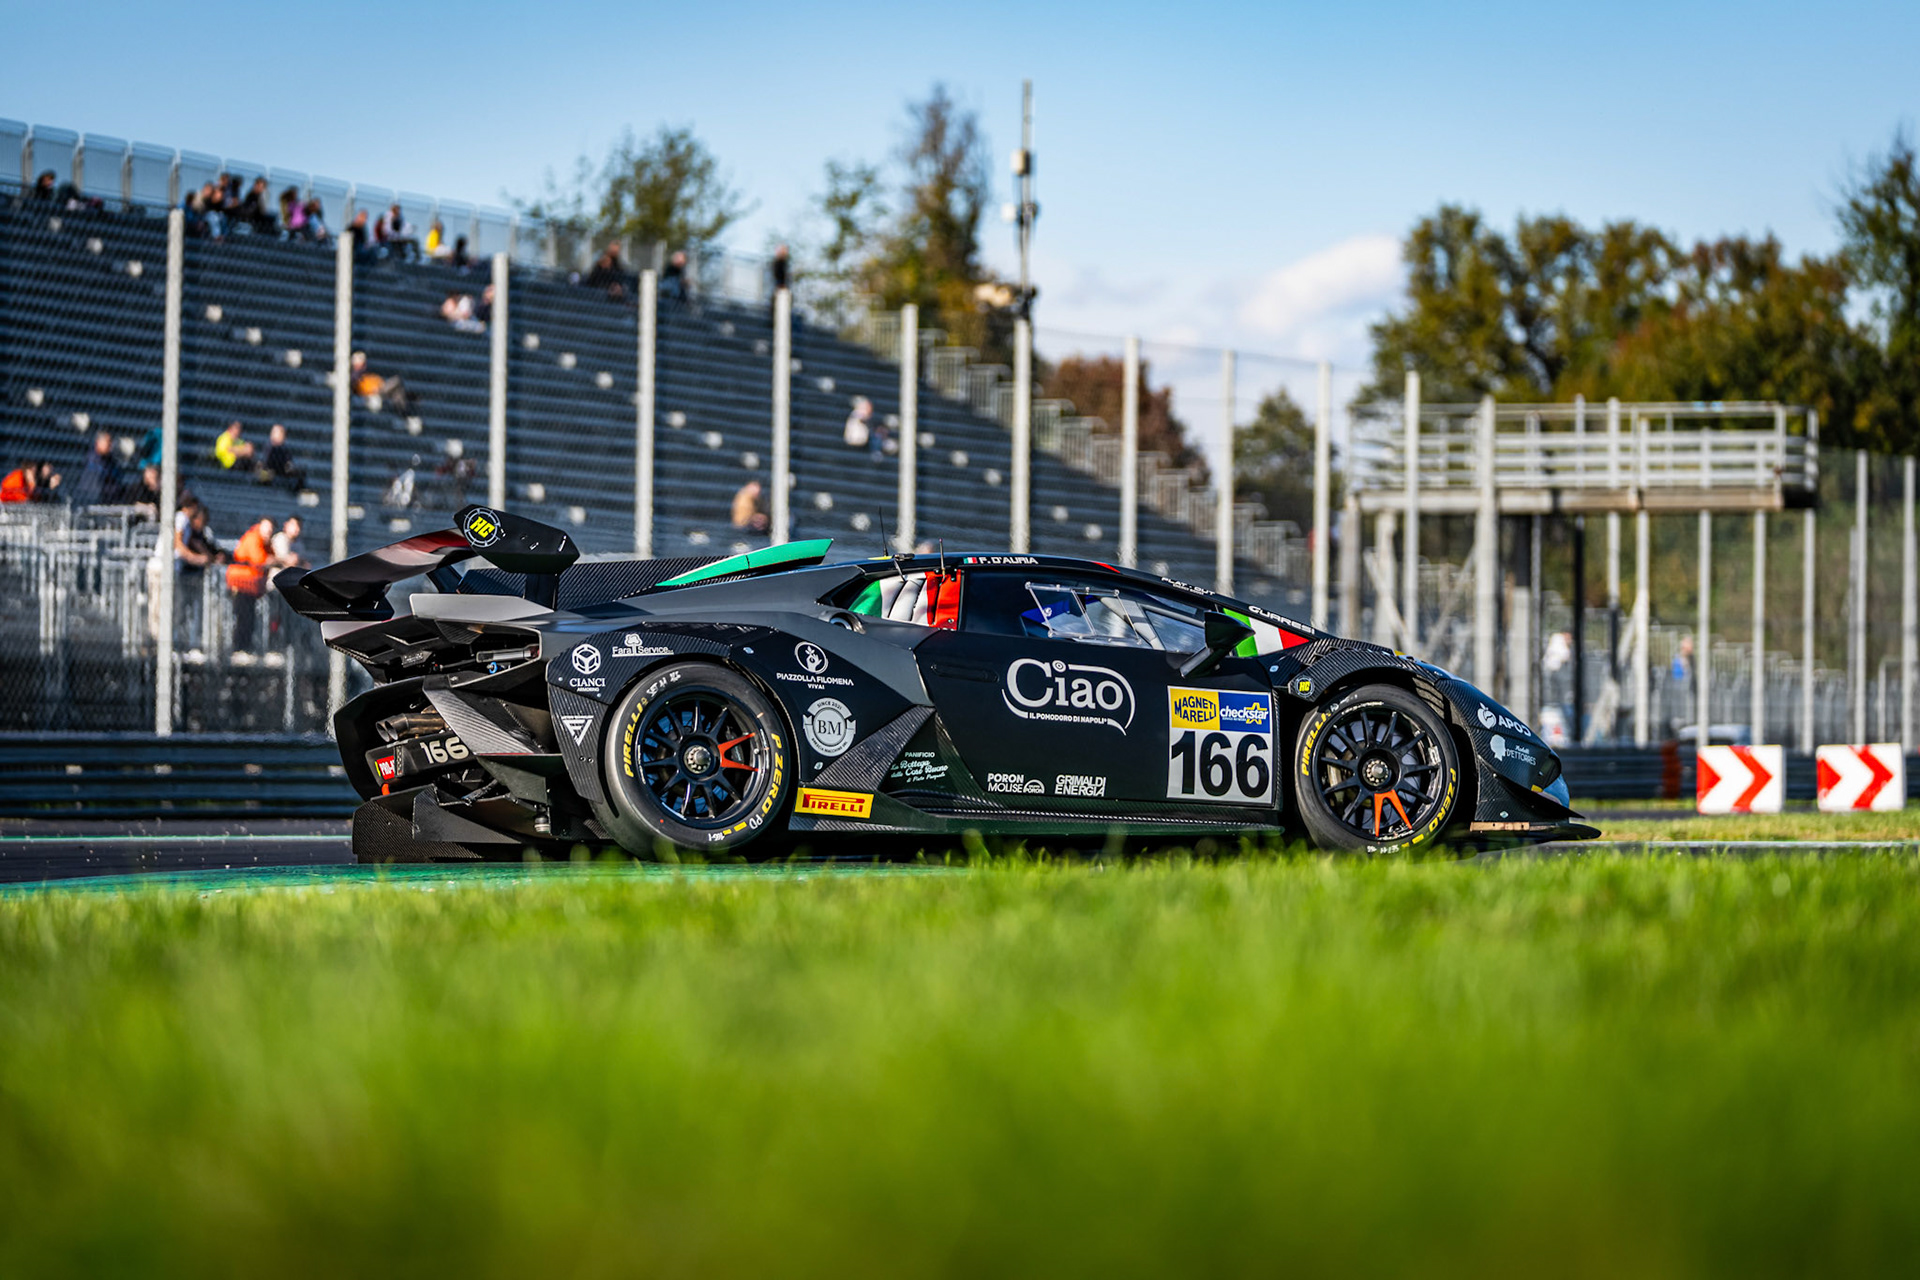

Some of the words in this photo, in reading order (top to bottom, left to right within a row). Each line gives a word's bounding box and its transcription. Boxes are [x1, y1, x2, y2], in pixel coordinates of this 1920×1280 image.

[1161, 577, 1187, 588] FLAT
[1194, 587, 1216, 596] OUT
[1248, 605, 1315, 635] GUARESI
[612, 646, 631, 655] Fara
[638, 645, 668, 654] Service
[569, 678, 606, 687] CIANCI
[776, 672, 816, 683] PIAZZOLLA
[816, 676, 855, 686] FILOMENA
[1006, 658, 1124, 710] Ciao
[1174, 696, 1217, 712] MAGNETI
[1036, 712, 1073, 722] POMODORO
[1073, 715, 1080, 723] DI
[1175, 707, 1217, 723] MARELLI
[1219, 705, 1269, 720] checkstar
[817, 719, 842, 736] BM
[623, 702, 643, 778] PIRELLI
[771, 733, 782, 749] P
[1301, 712, 1327, 776] PIRELLI
[419, 736, 469, 764] 166
[1171, 730, 1270, 798] 166
[762, 751, 783, 814] ZERO
[987, 773, 1024, 784] PORON
[1055, 774, 1107, 787] GRIMALDI
[987, 783, 1023, 793] MOLISE
[1054, 784, 1105, 797] ENERGIA
[802, 794, 865, 813] PIRELLI
[1428, 782, 1455, 832] ZERO
